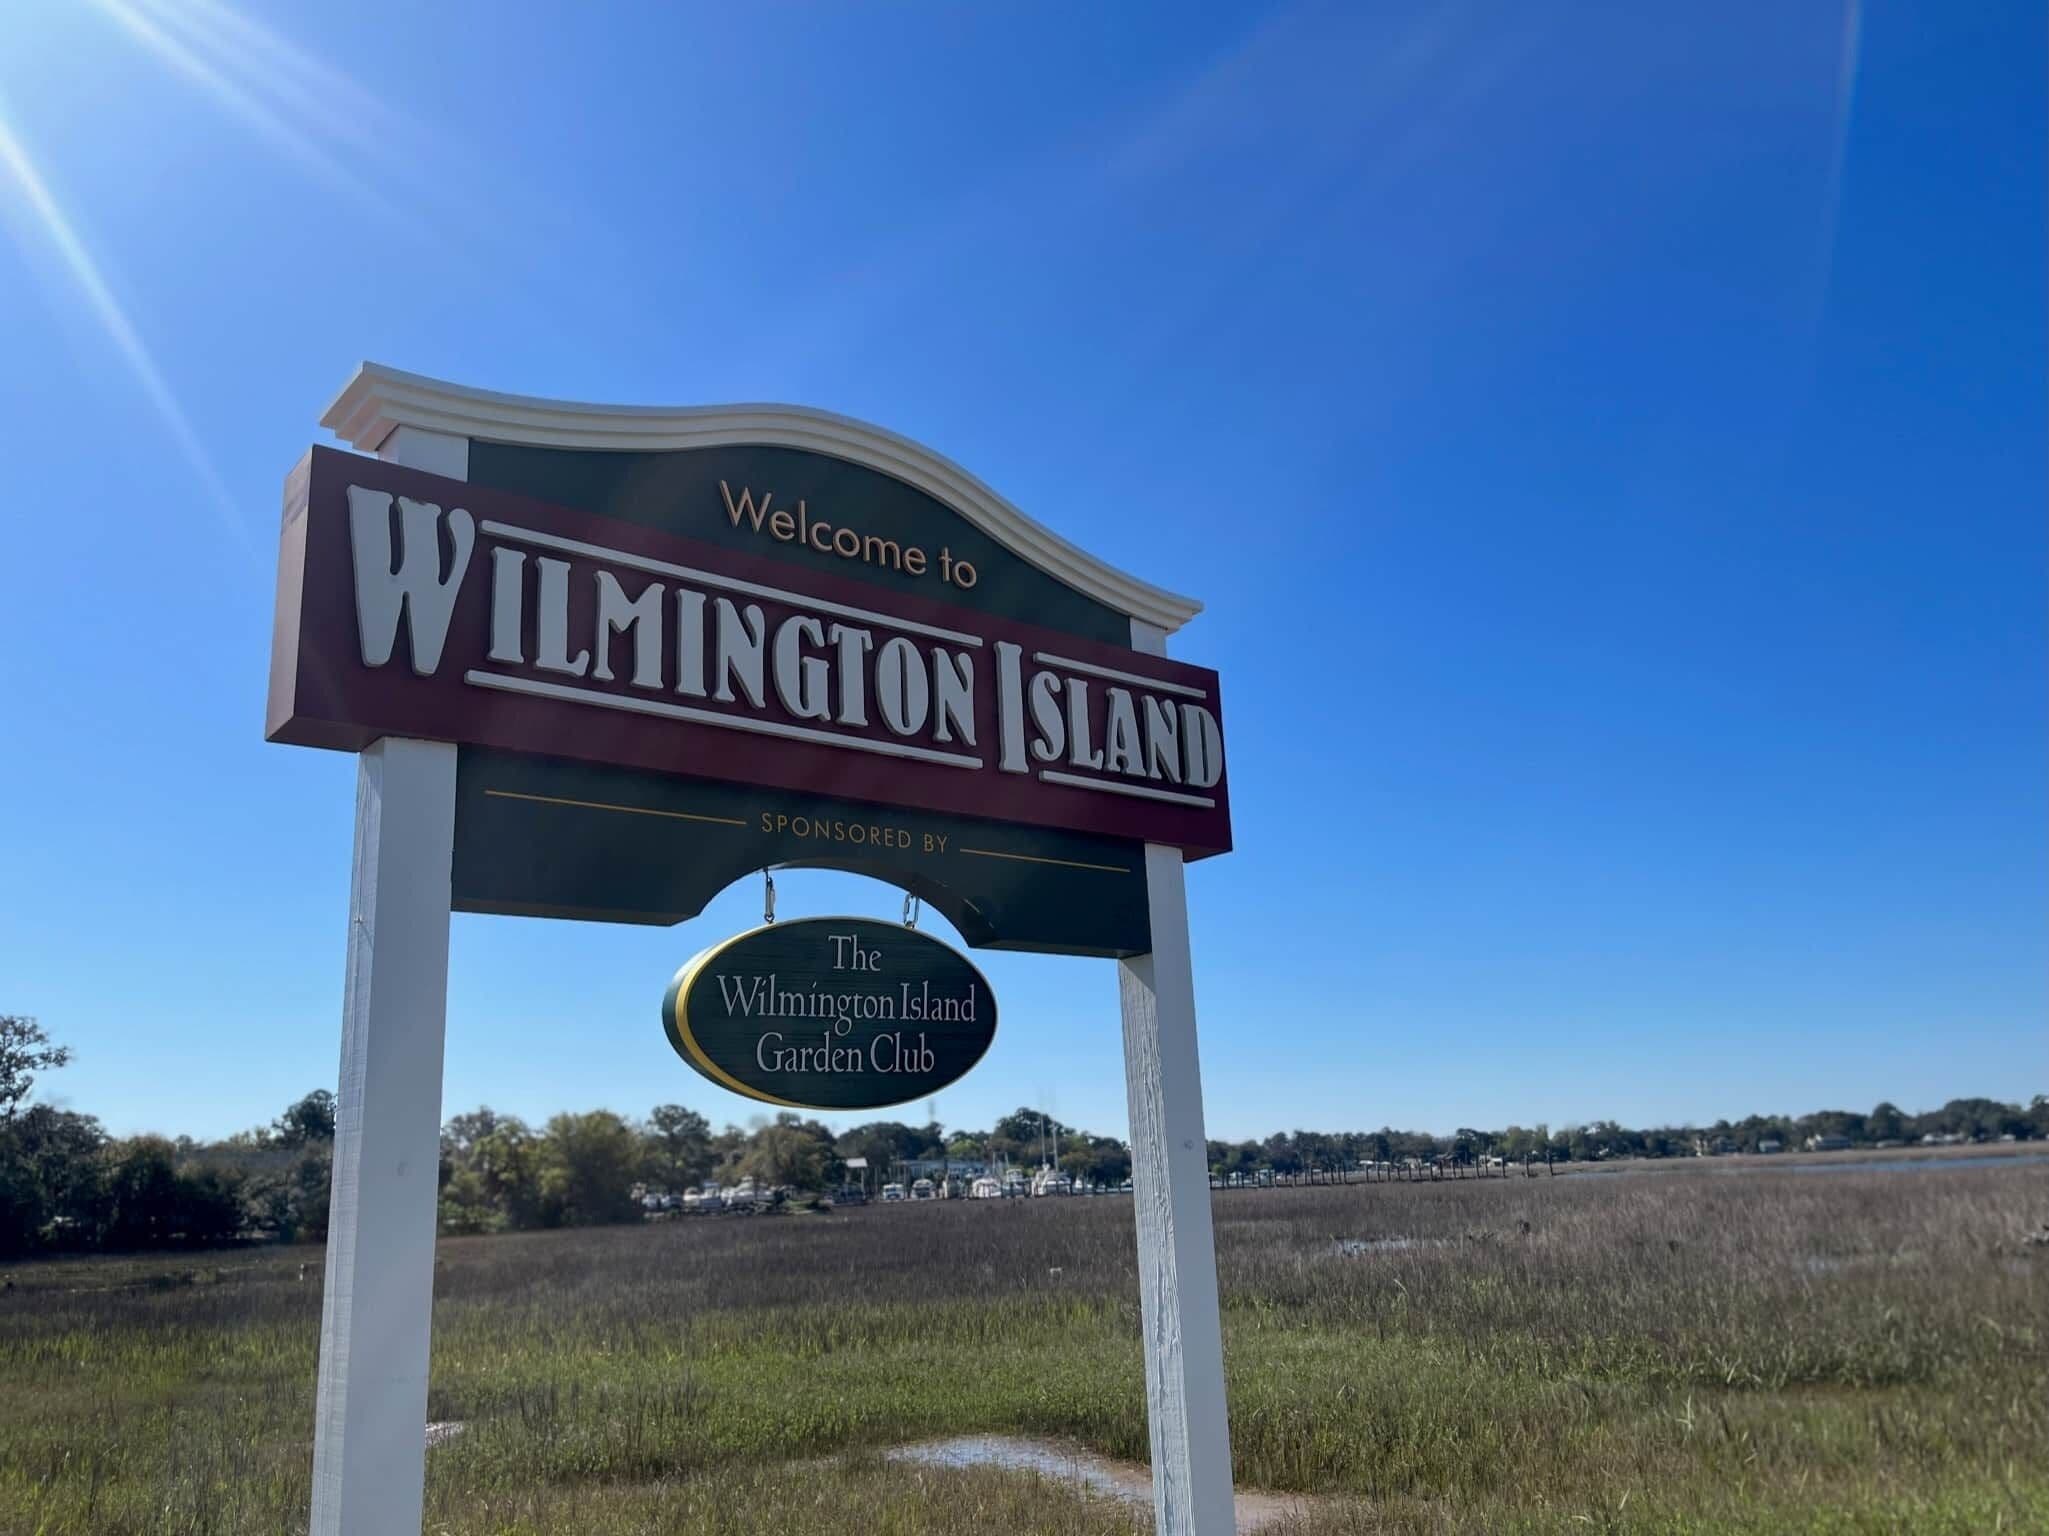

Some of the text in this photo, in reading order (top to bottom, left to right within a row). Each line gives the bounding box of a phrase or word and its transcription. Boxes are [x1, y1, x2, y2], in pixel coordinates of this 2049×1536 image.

[718, 478, 978, 589] Welcome to
[347, 484, 1223, 788] WILMINGTON ISLAND
[761, 812, 949, 854] SPONSORED BY
[828, 934, 882, 972] The
[716, 973, 977, 1037] Wilmington Island
[755, 1031, 936, 1074] Garden Club
